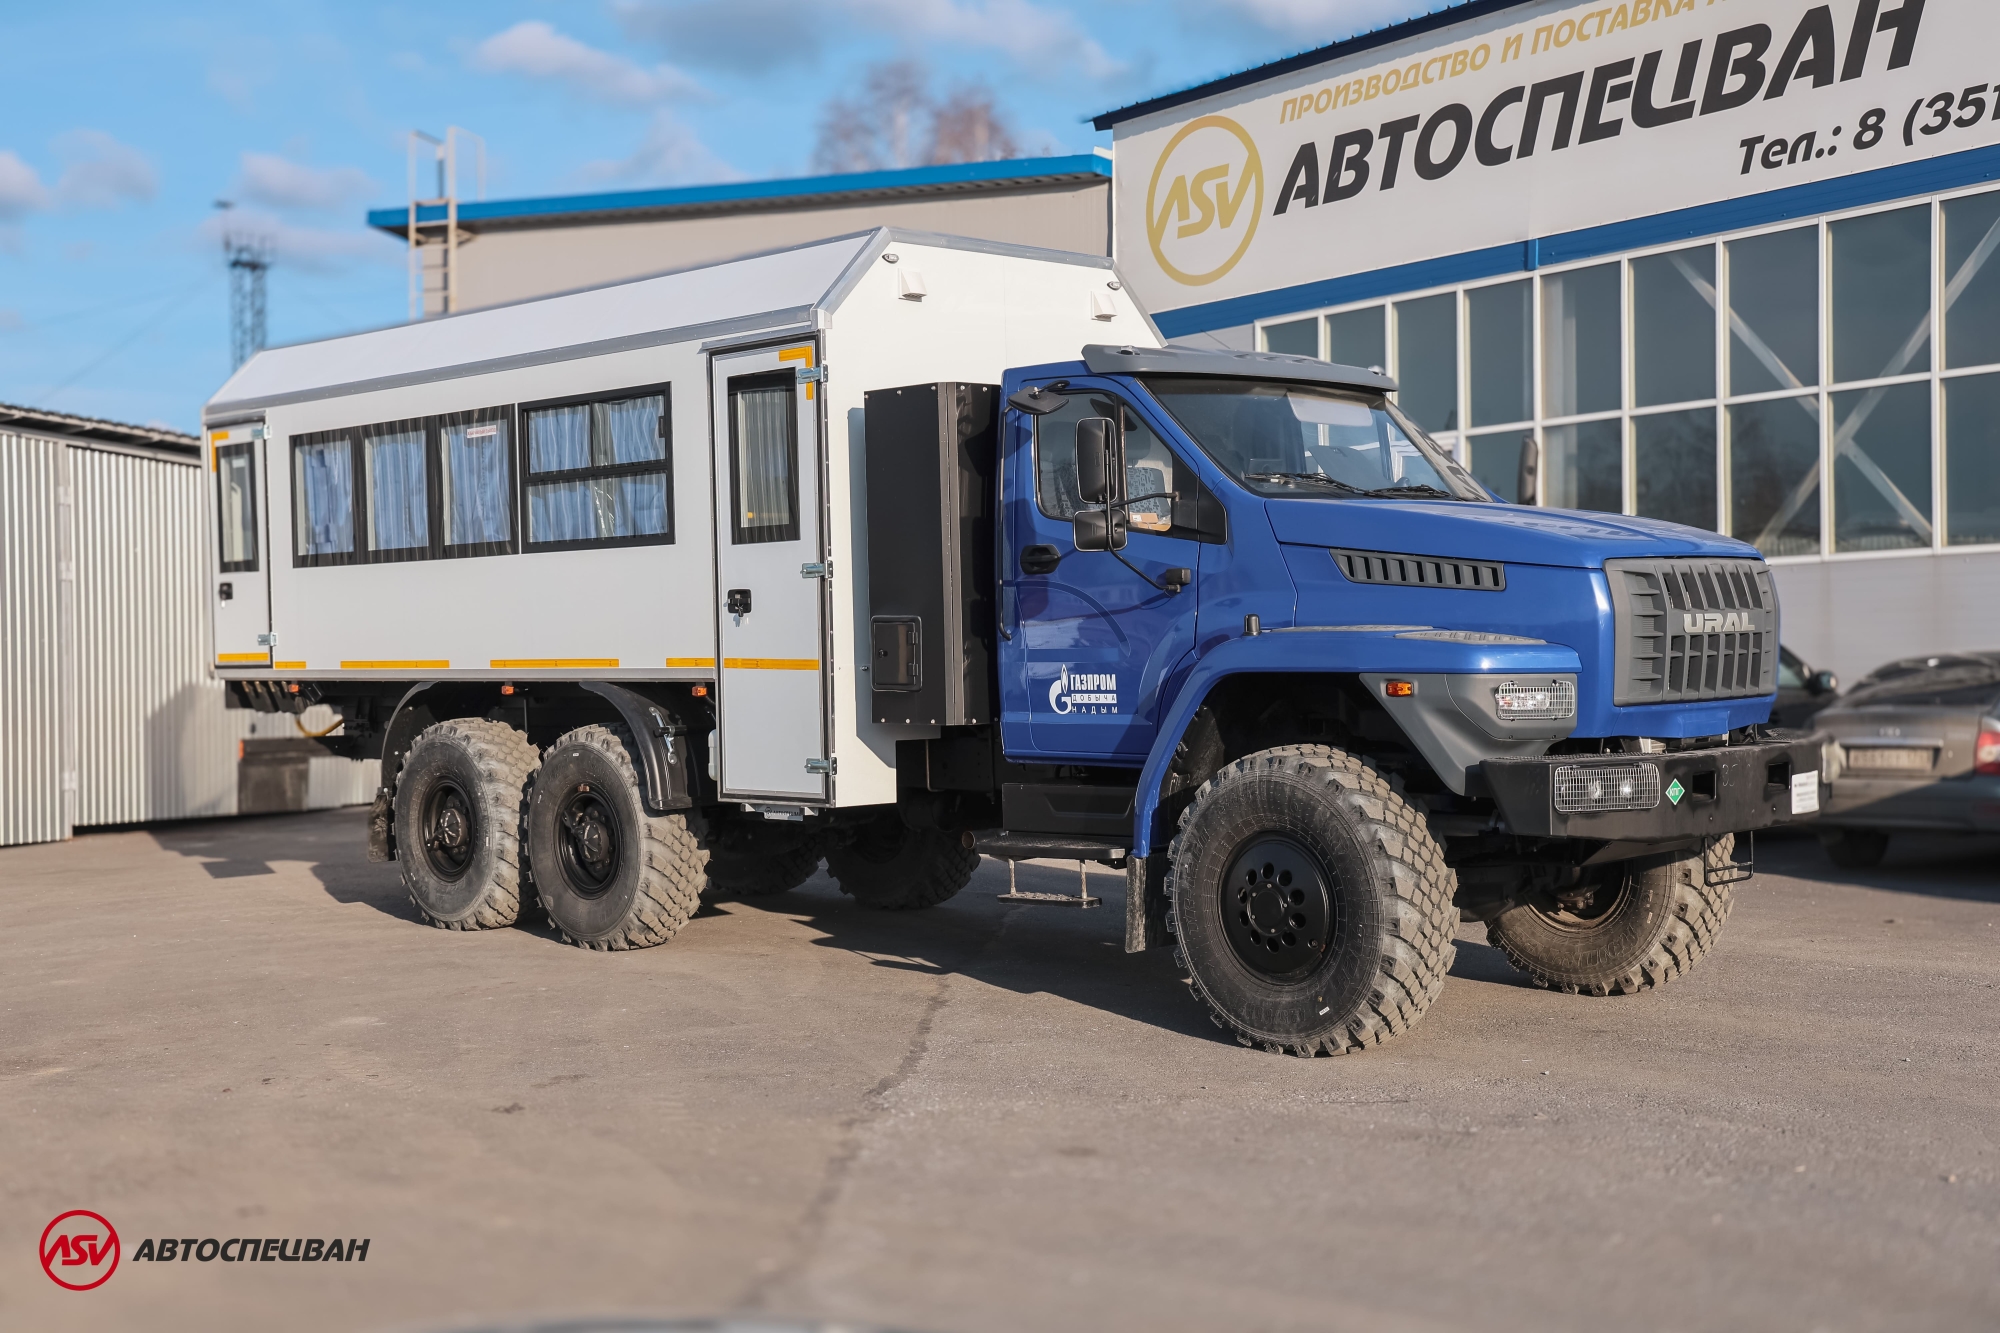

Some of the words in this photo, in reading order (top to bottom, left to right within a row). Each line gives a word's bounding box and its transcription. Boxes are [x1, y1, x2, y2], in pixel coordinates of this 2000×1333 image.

[1279, 43, 1491, 125] ПРОИЗВОДСТВО
[1500, 33, 1524, 64] И
[1273, 0, 1926, 217] АВТОСПЕЦВАН
[1739, 125, 1842, 176] Тел.:
[1853, 107, 1887, 150] 8
[1683, 612, 1755, 633] URAL
[1070, 674, 1117, 691] ГАЗПРОМ
[1072, 694, 1116, 703] ДОБЫЧА
[1071, 705, 1118, 715] НАДЫМ
